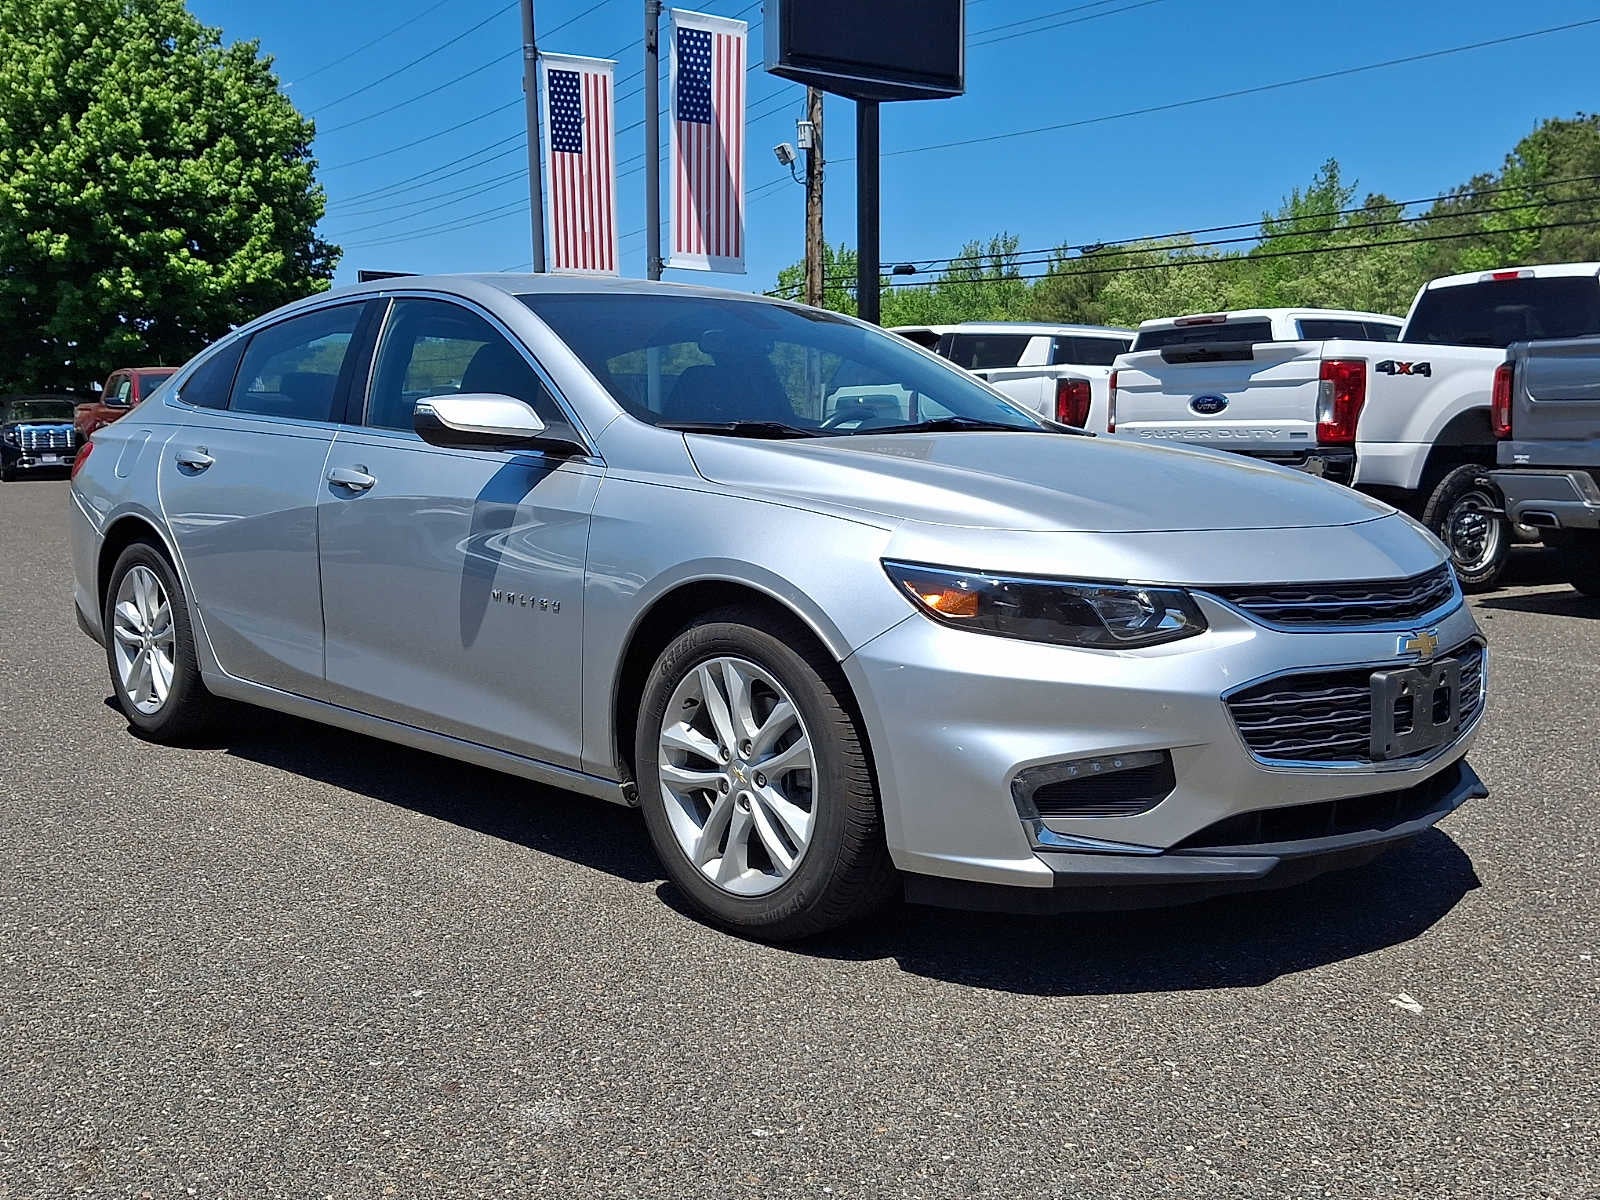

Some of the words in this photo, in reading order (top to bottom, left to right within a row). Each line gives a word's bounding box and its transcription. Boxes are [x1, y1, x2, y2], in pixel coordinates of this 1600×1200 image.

[1139, 428, 1210, 439] SUPER
[1218, 428, 1282, 439] DUTY
[491, 588, 561, 614] MALIBU
